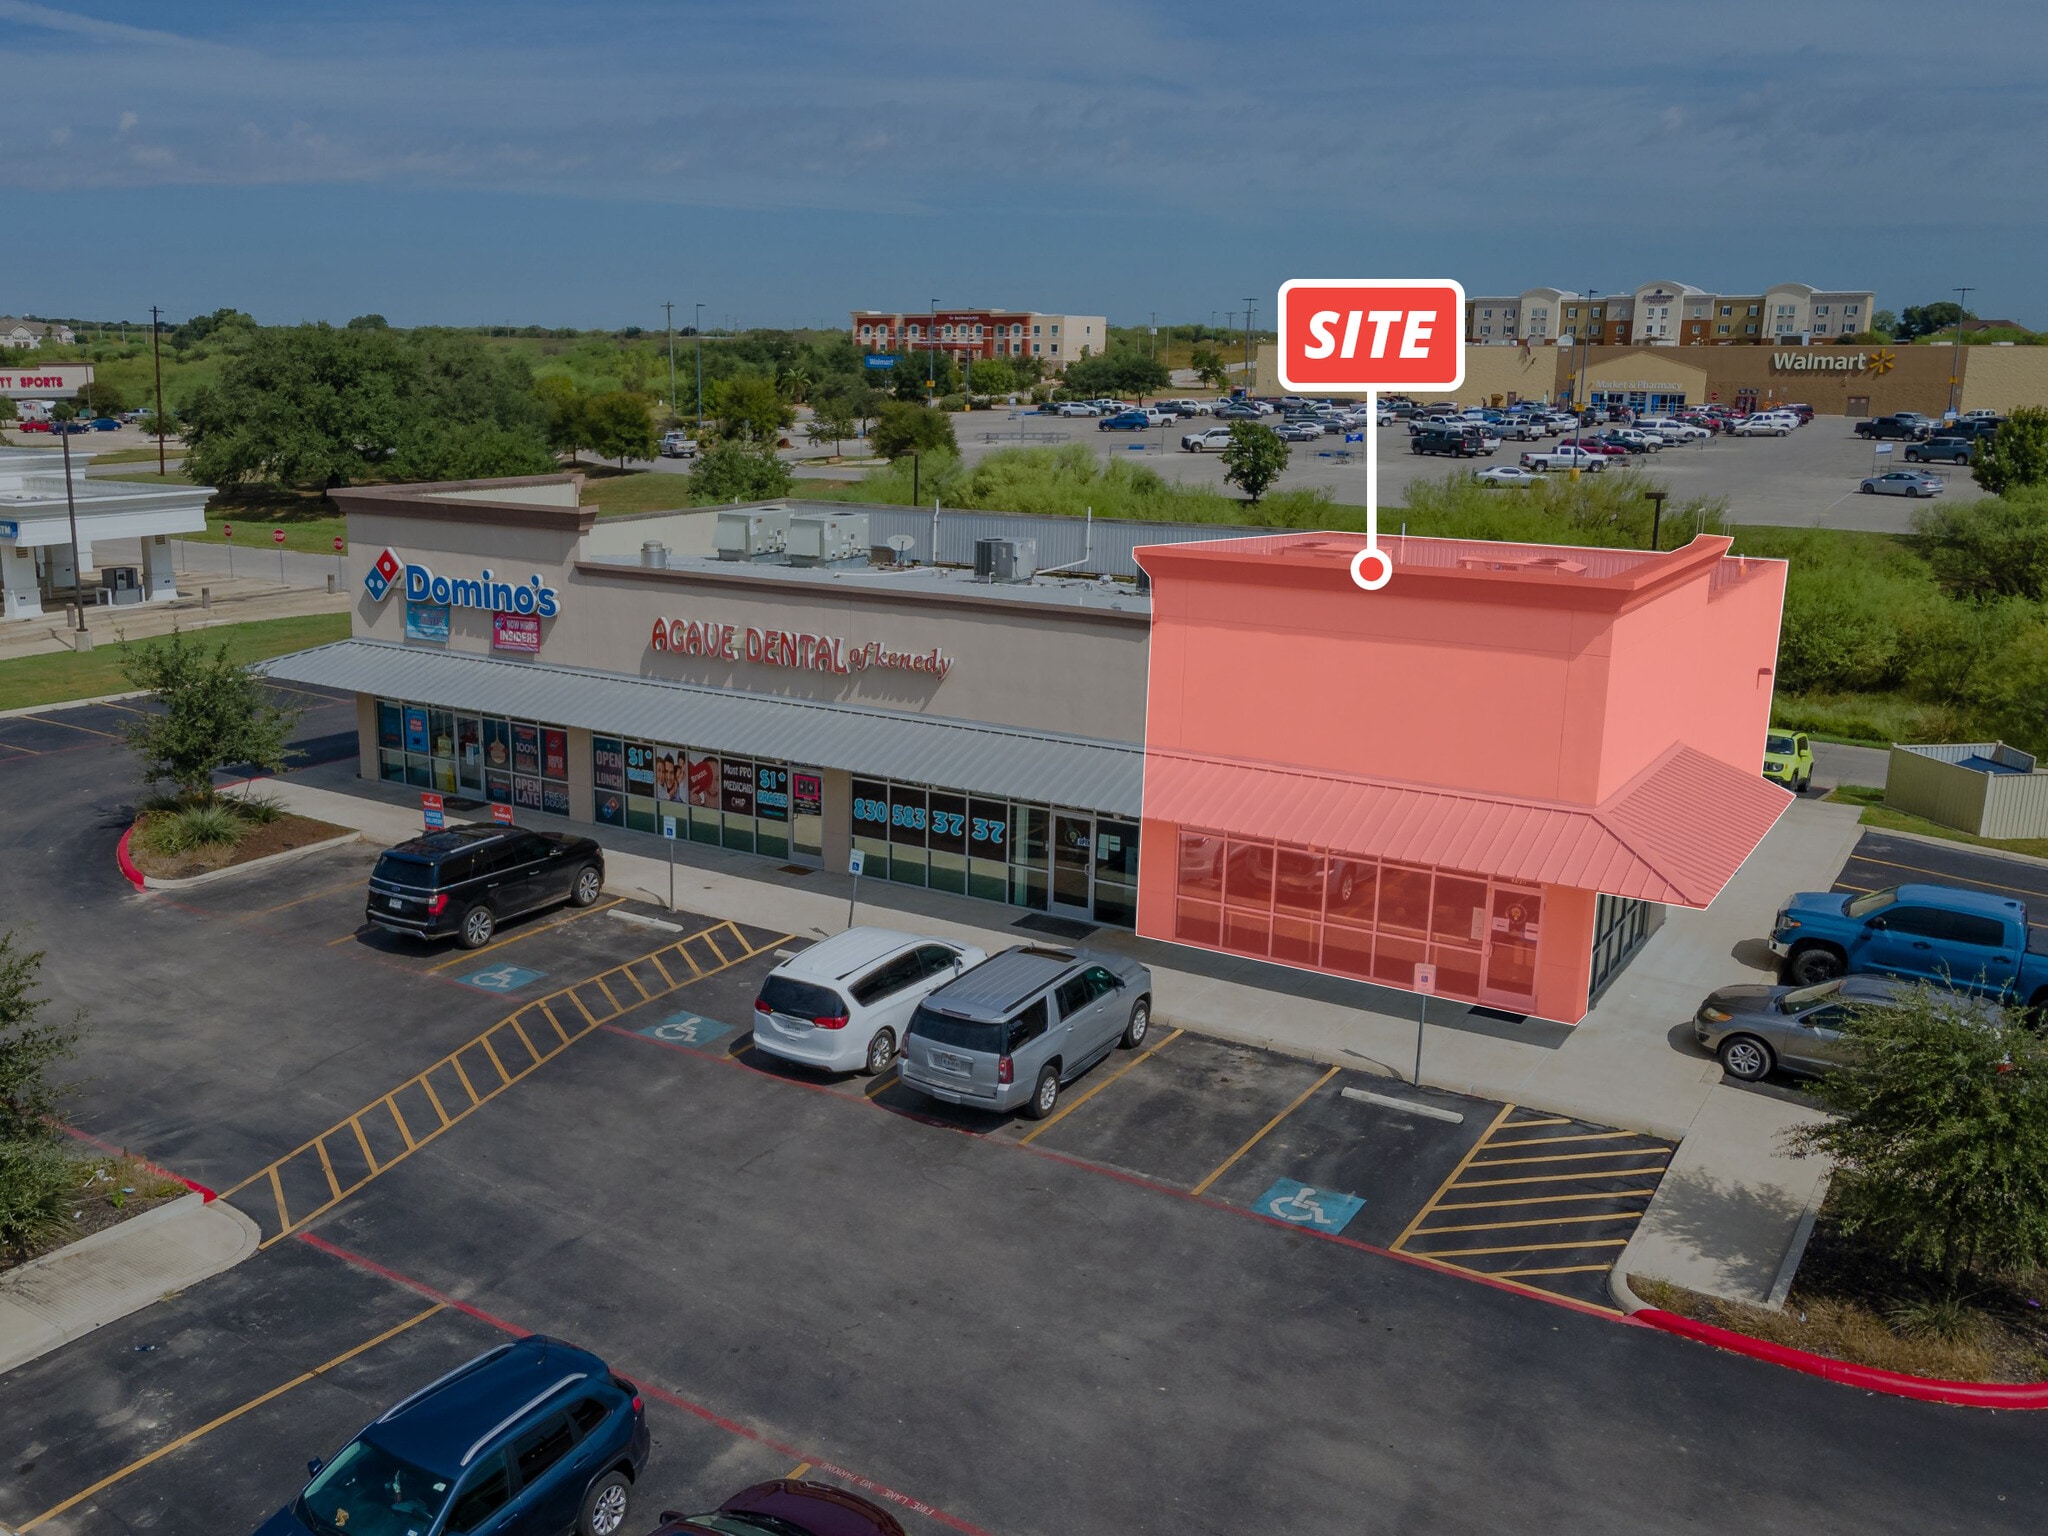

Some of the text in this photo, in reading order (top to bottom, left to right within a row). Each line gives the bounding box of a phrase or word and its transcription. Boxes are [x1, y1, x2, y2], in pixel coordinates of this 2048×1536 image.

[1773, 352, 1867, 371] Walmart
[20, 376, 63, 388] SPORTS
[1595, 380, 1626, 389] Market
[1637, 380, 1683, 390] Pharmacy
[405, 564, 560, 618] Domino's
[499, 630, 538, 644] INSIDERS
[652, 616, 738, 662] AGAVE
[745, 627, 849, 674] DENTAL
[849, 642, 875, 671] of
[515, 742, 538, 755] 100%
[596, 750, 621, 768] OPEN
[723, 764, 752, 778] Most PPO
[515, 778, 540, 792] OPEN
[596, 771, 622, 788] LUNCH
[723, 780, 753, 794] MEDICAID
[516, 790, 540, 806] LATE
[757, 790, 788, 808] BRACES
[854, 798, 1006, 844] 830 583 37 37
[880, 1489, 908, 1504] LANE
[909, 1501, 935, 1516] FIRE
